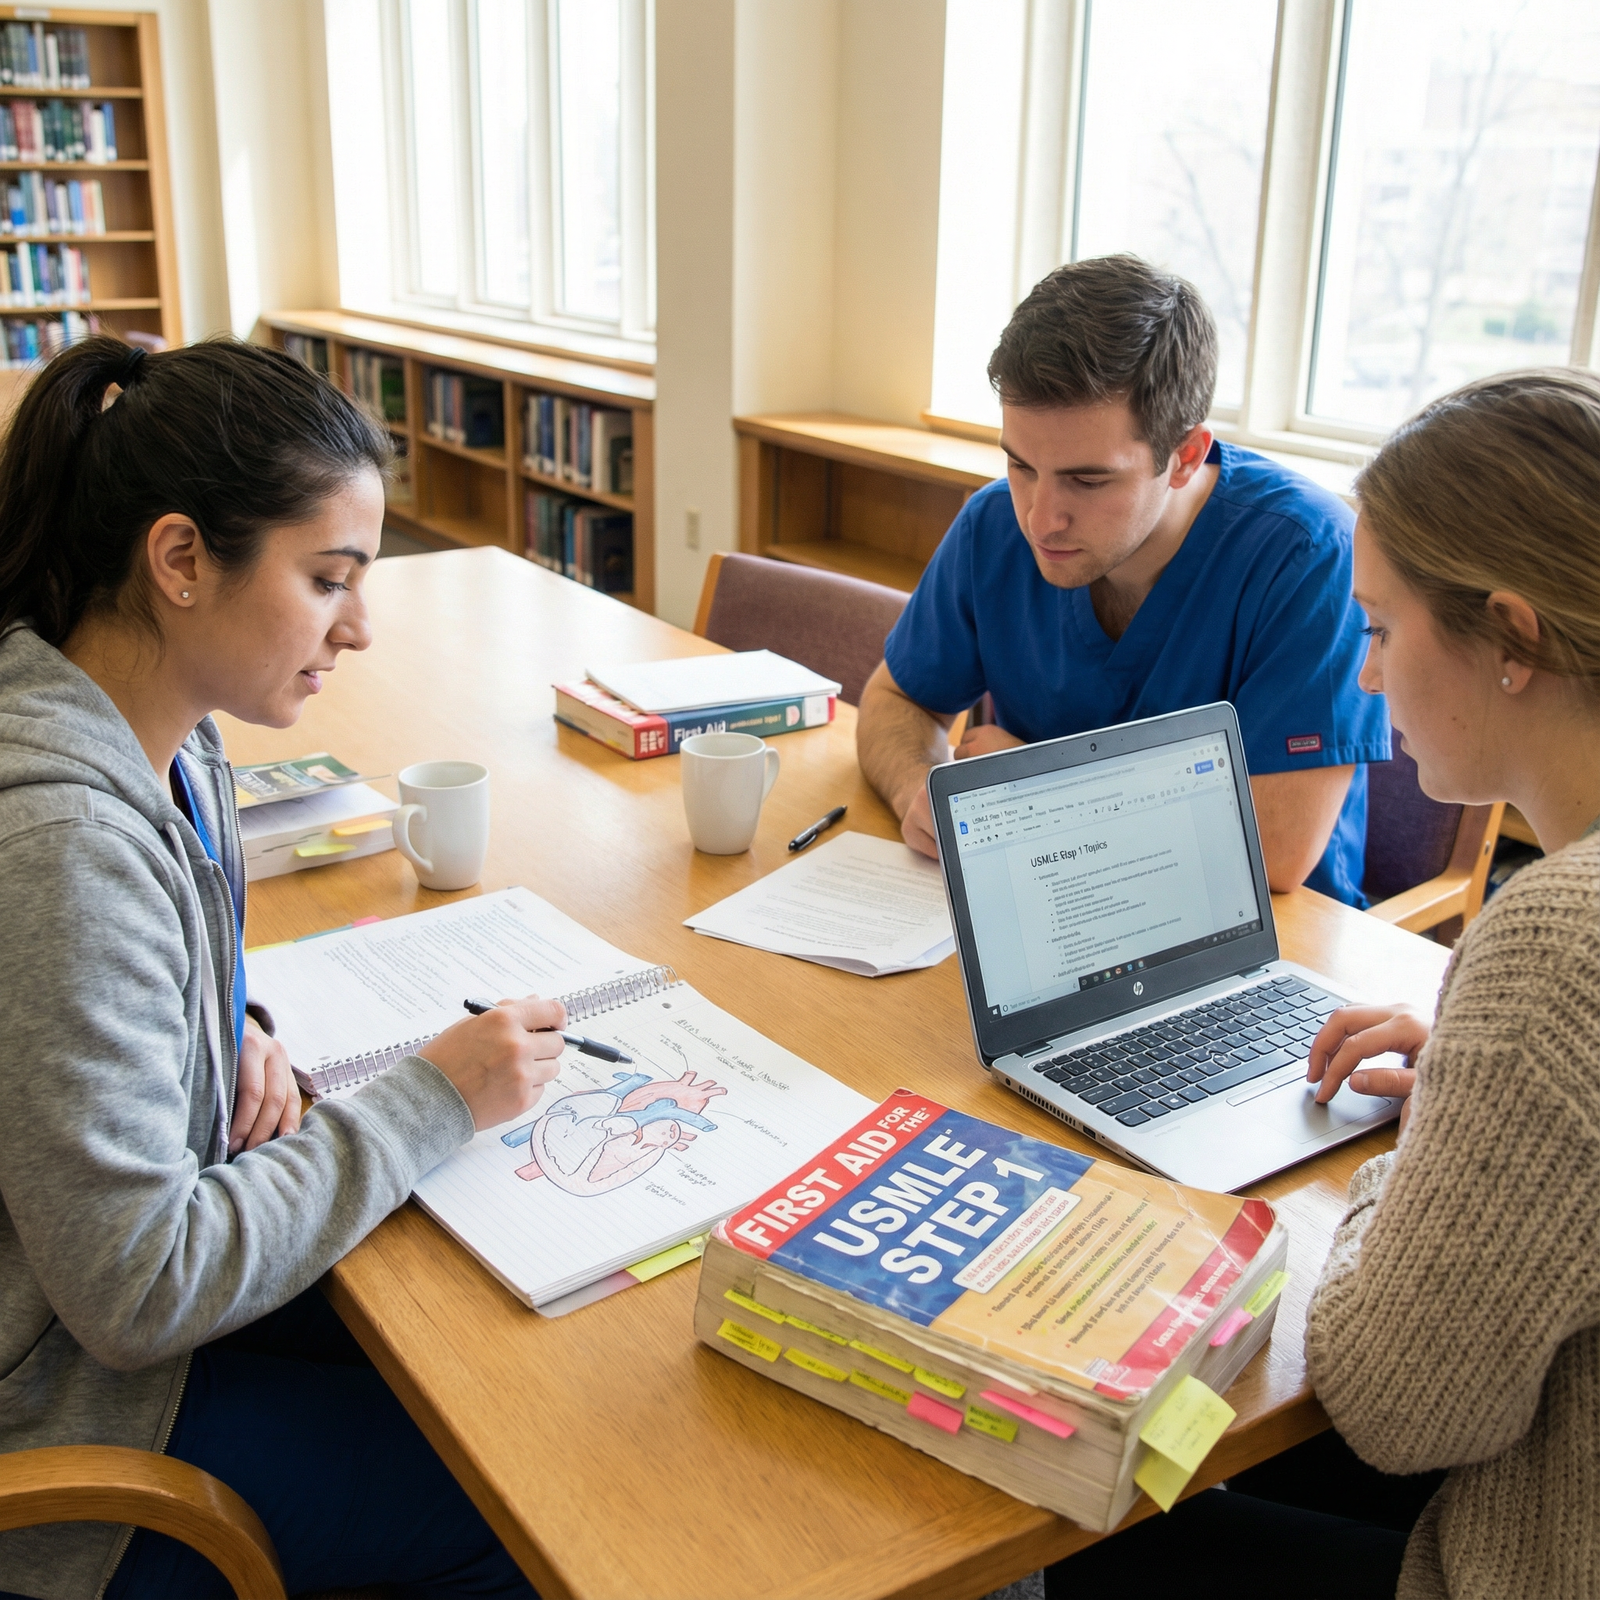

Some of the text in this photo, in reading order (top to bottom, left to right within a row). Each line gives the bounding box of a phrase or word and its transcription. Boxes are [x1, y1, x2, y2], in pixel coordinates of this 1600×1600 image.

[1030, 851, 1059, 868] USMLE
[1078, 845, 1083, 855] 1
[1083, 840, 1108, 854] Topics
[876, 1106, 911, 1130] FOR
[896, 1110, 930, 1133] THE
[733, 1167, 843, 1248] FIRST
[833, 1129, 897, 1177] AID
[812, 1134, 988, 1257] USMLE
[880, 1181, 1010, 1285] STEP
[992, 1157, 1045, 1182] 1
